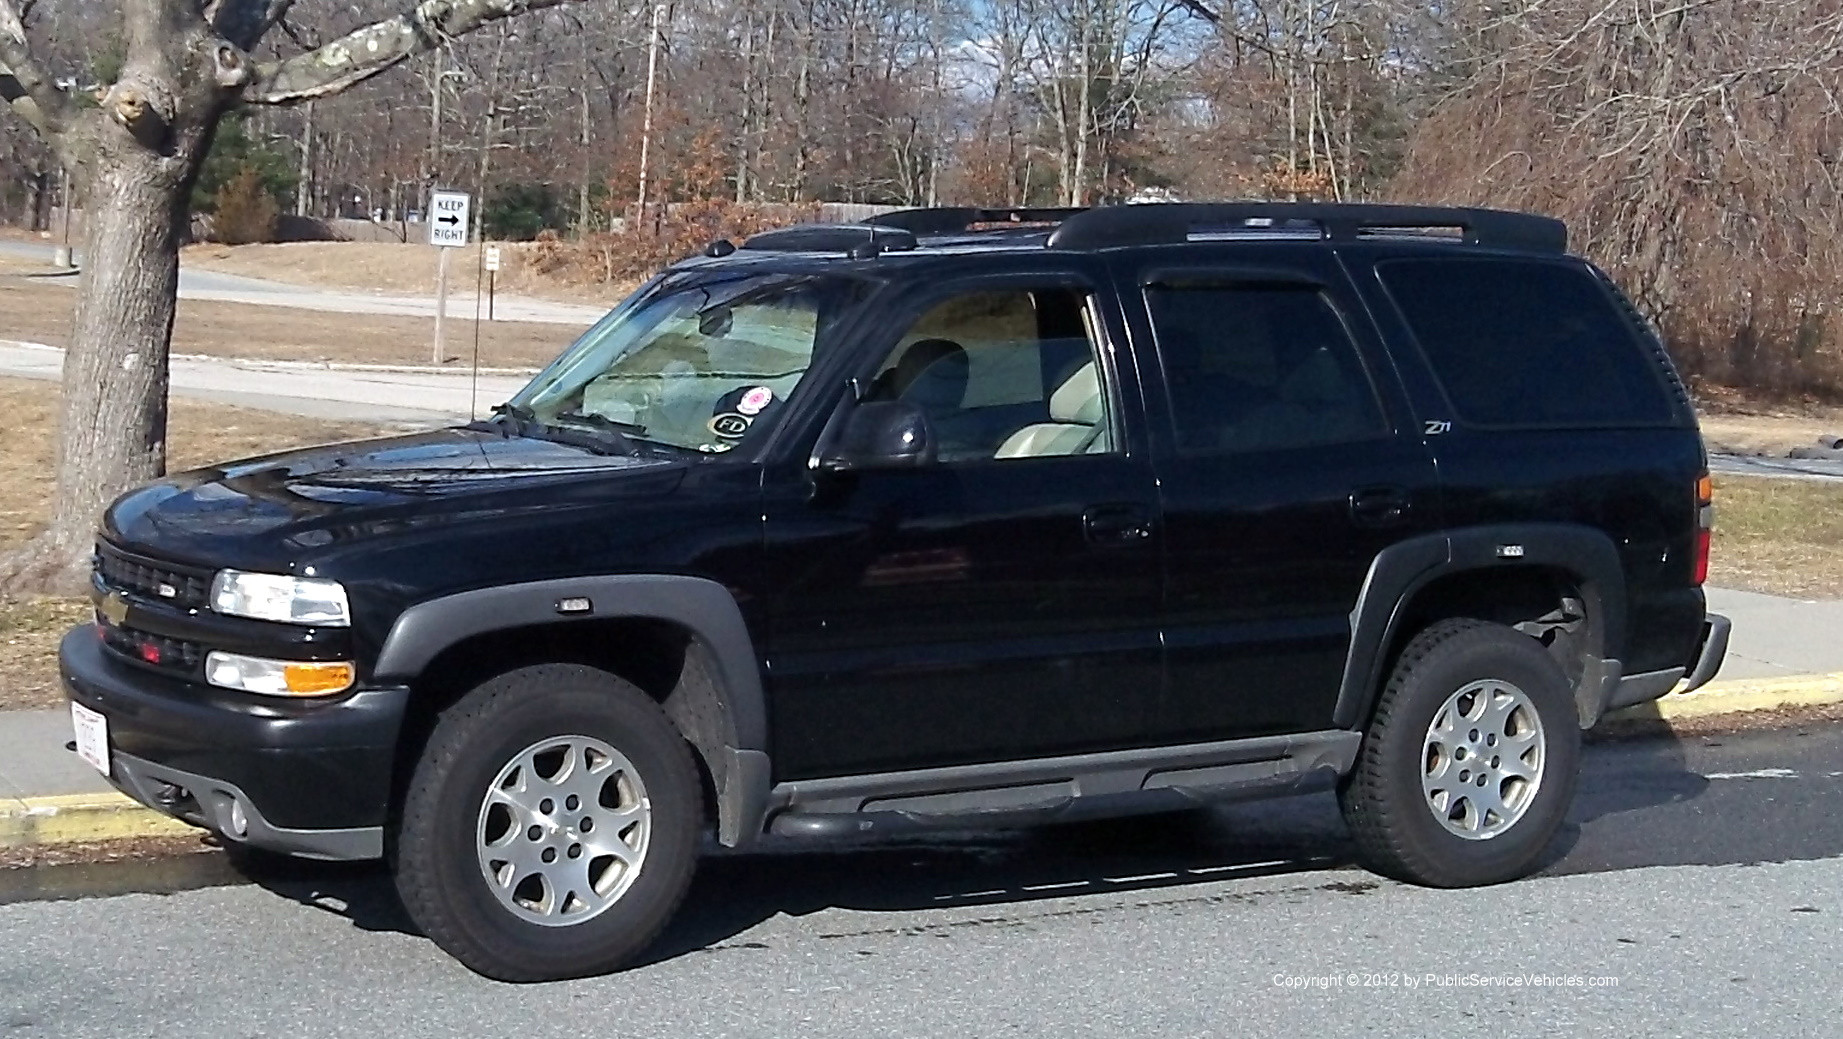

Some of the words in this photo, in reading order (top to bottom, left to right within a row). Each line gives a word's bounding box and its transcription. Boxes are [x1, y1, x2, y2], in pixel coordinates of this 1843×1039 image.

[437, 200, 464, 212] KEEP
[434, 228, 464, 240] RIGHT
[718, 418, 746, 432] FD
